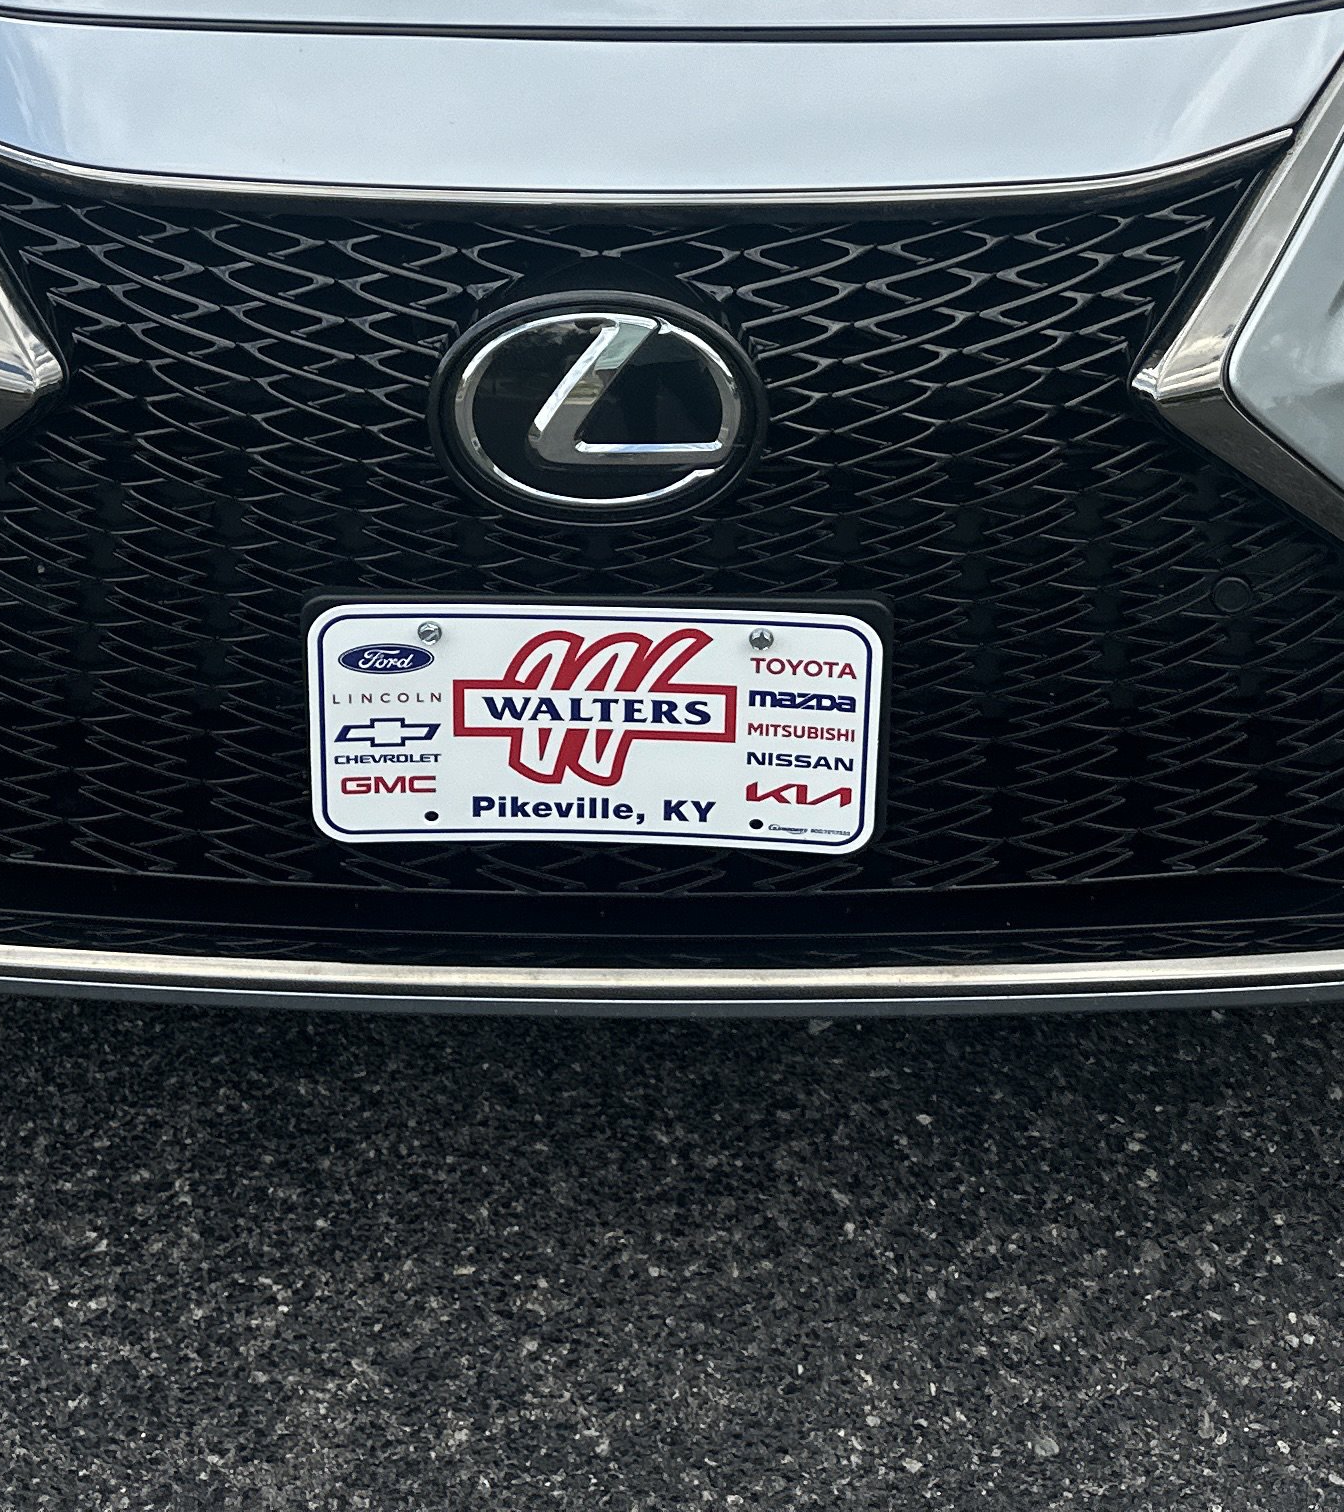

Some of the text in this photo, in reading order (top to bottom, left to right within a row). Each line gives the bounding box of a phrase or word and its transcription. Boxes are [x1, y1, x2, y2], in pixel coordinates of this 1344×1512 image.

[357, 649, 415, 669] Ford
[750, 657, 857, 680] TOYOTA
[332, 692, 442, 705] LINCOLN
[481, 696, 712, 726] WALTERS
[747, 722, 856, 743] MITSUBISHI
[333, 753, 443, 765] CHEVROLET
[746, 751, 854, 772] NISSAN
[340, 775, 437, 795] GMC
[745, 781, 852, 808] KIA
[472, 795, 717, 825] Pikeville, KY
